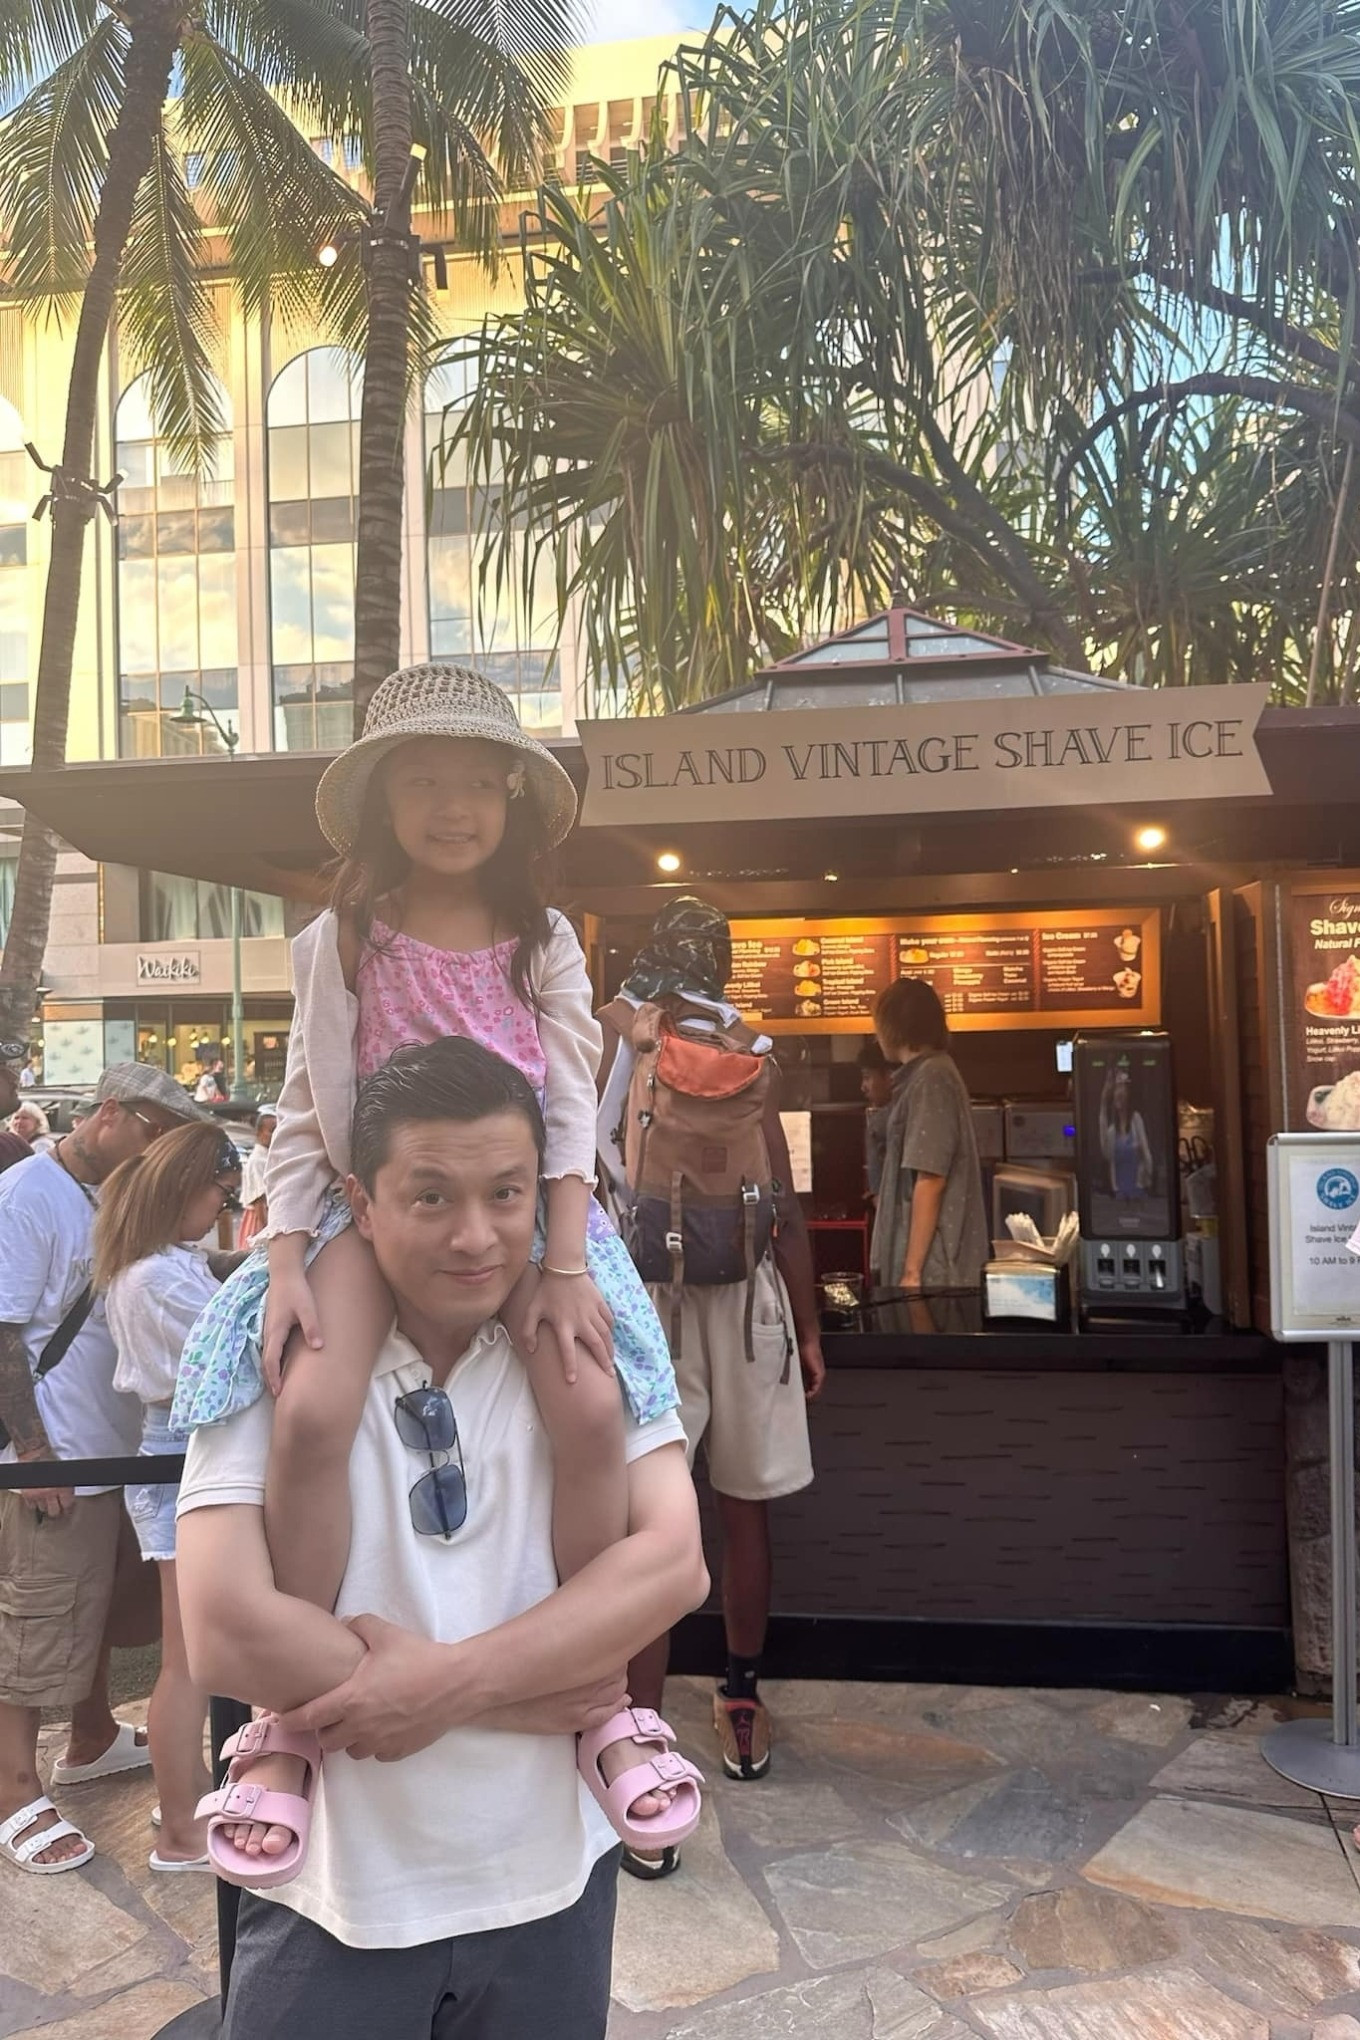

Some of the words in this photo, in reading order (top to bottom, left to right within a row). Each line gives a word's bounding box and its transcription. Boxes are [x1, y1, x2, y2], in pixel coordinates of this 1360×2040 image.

[601, 747, 767, 790] ISLAND
[781, 734, 979, 781] VINTAGE
[994, 724, 1152, 769] SHAVE
[1167, 719, 1243, 759] ICE
[1314, 937, 1353, 950] Natural
[137, 954, 198, 980] Waikiki
[1305, 1025, 1350, 1037] Heavenly
[1310, 1224, 1336, 1232] Island
[1305, 1235, 1332, 1244] Shave
[1333, 1235, 1348, 1243] Ice
[1309, 1256, 1320, 1265] 10
[1321, 1256, 1337, 1265] AM
[1338, 1257, 1348, 1265] to
